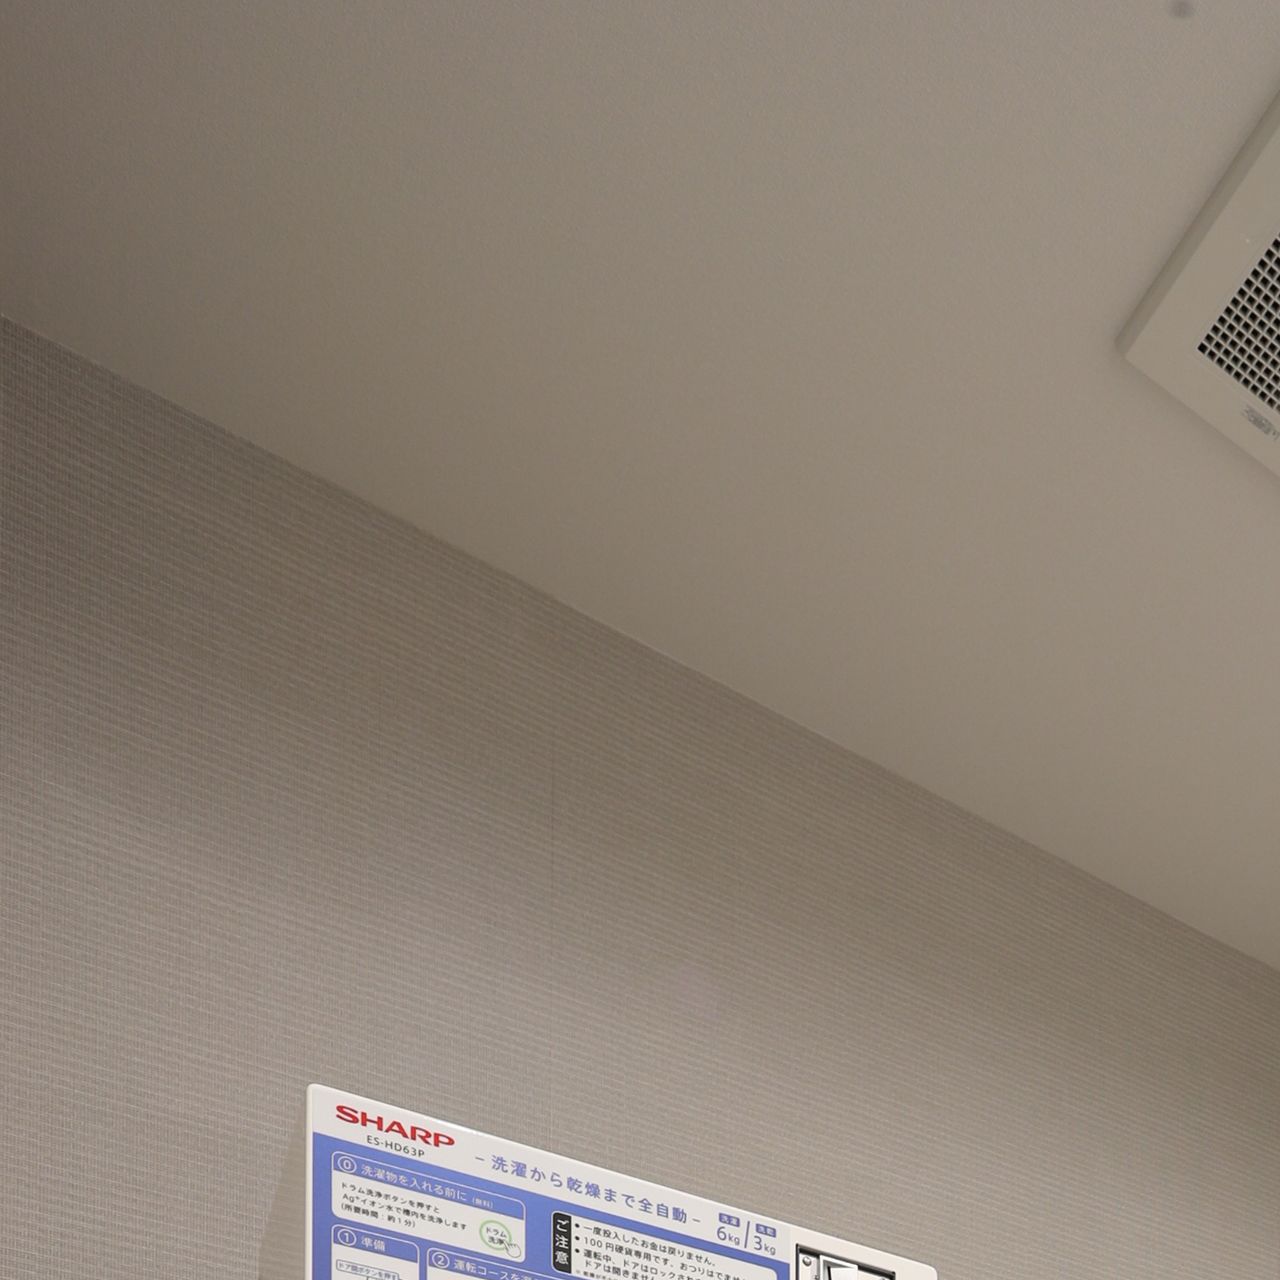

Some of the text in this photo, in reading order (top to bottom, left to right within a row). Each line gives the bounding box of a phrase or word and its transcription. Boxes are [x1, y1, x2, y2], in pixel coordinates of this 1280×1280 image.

[335, 1105, 455, 1148] SHARP
[366, 1135, 425, 1158] ES-HD63P
[360, 1164, 468, 1201] 洗濯物を入れる前に
[341, 1182, 440, 1214] ドラム洗浄ボタンを押すと
[360, 1237, 386, 1252] 準備
[485, 1227, 507, 1239] ドラム
[555, 1219, 570, 1265] ご注意
[583, 1226, 716, 1267] 一度投入したお金は戻りません。
[716, 1227, 740, 1246] 6kg
[753, 1236, 776, 1255] 3kg
